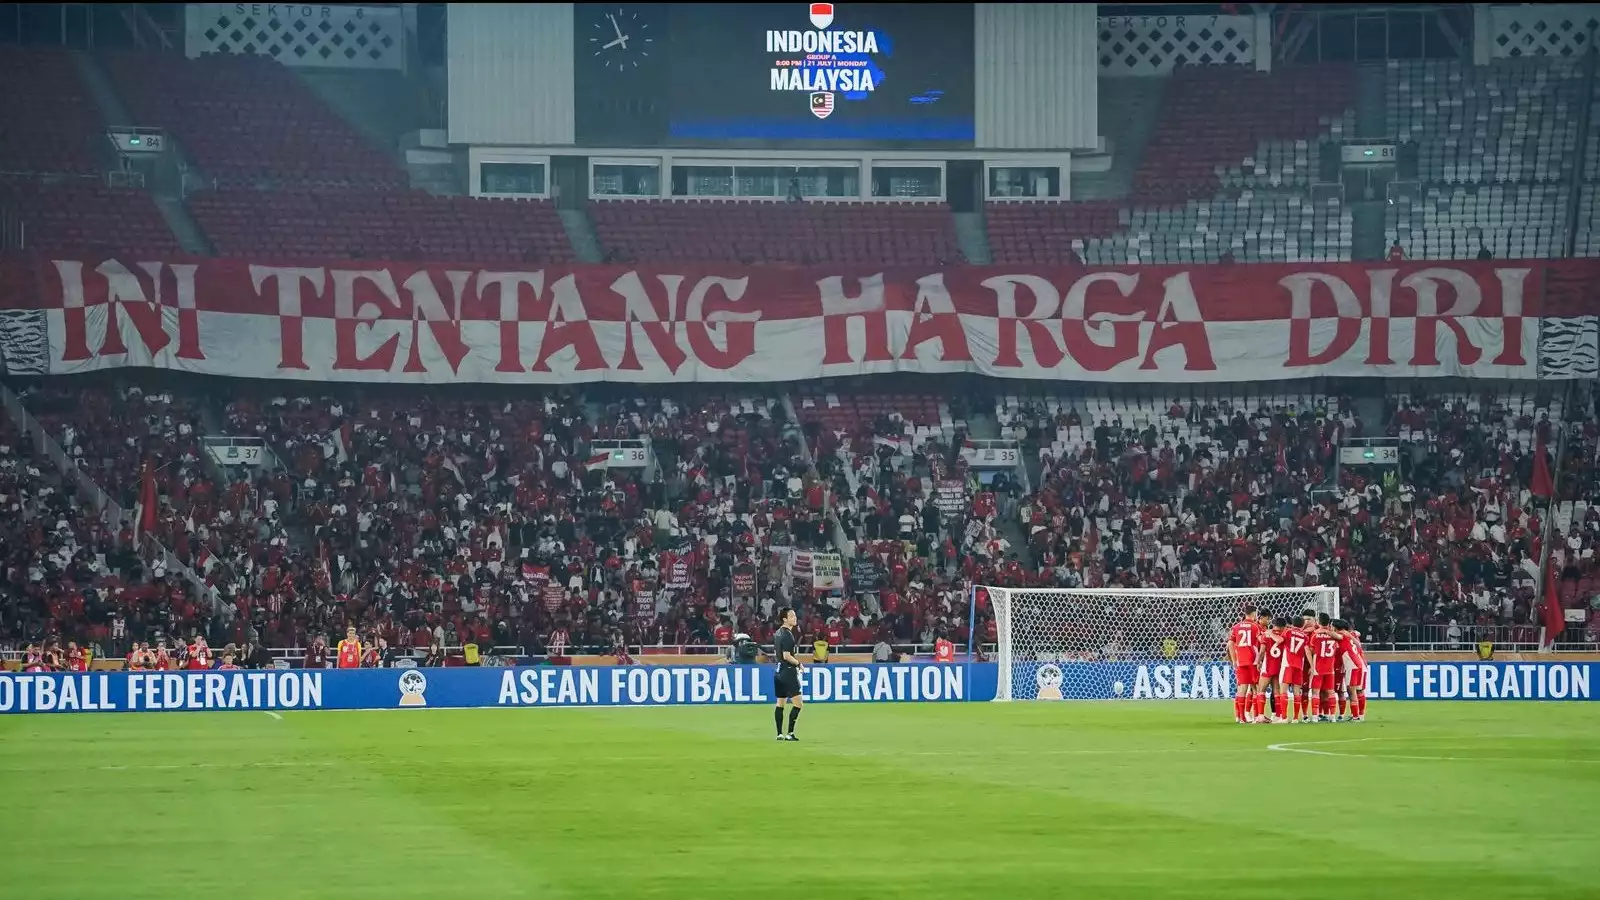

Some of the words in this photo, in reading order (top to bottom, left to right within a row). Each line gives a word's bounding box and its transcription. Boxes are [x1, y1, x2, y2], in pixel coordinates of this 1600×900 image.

[235, 3, 331, 18] SEKTOR
[766, 30, 878, 53] INDONESIA
[770, 68, 875, 91] MALAYSIA
[147, 137, 160, 147] 84
[1382, 147, 1395, 157] 81
[51, 258, 205, 361] INI
[249, 264, 762, 375] TENTANG
[815, 270, 1218, 372] HARGA
[1278, 267, 1531, 368] DIRI
[245, 448, 257, 459] 37
[632, 450, 645, 461] 36
[1001, 451, 1015, 461] 35
[1382, 448, 1396, 459] 34
[1238, 630, 1252, 647] 21
[1290, 636, 1305, 655] 17
[1270, 643, 1281, 658] 6
[1320, 640, 1336, 658] 13
[128, 672, 322, 709] FEDERATION
[498, 669, 599, 705] ASEAN
[611, 667, 768, 704] FOOTBALL
[796, 666, 963, 702] EDERATION
[1133, 665, 1231, 699] ASEAN
[1406, 664, 1591, 700] FEDERATION
